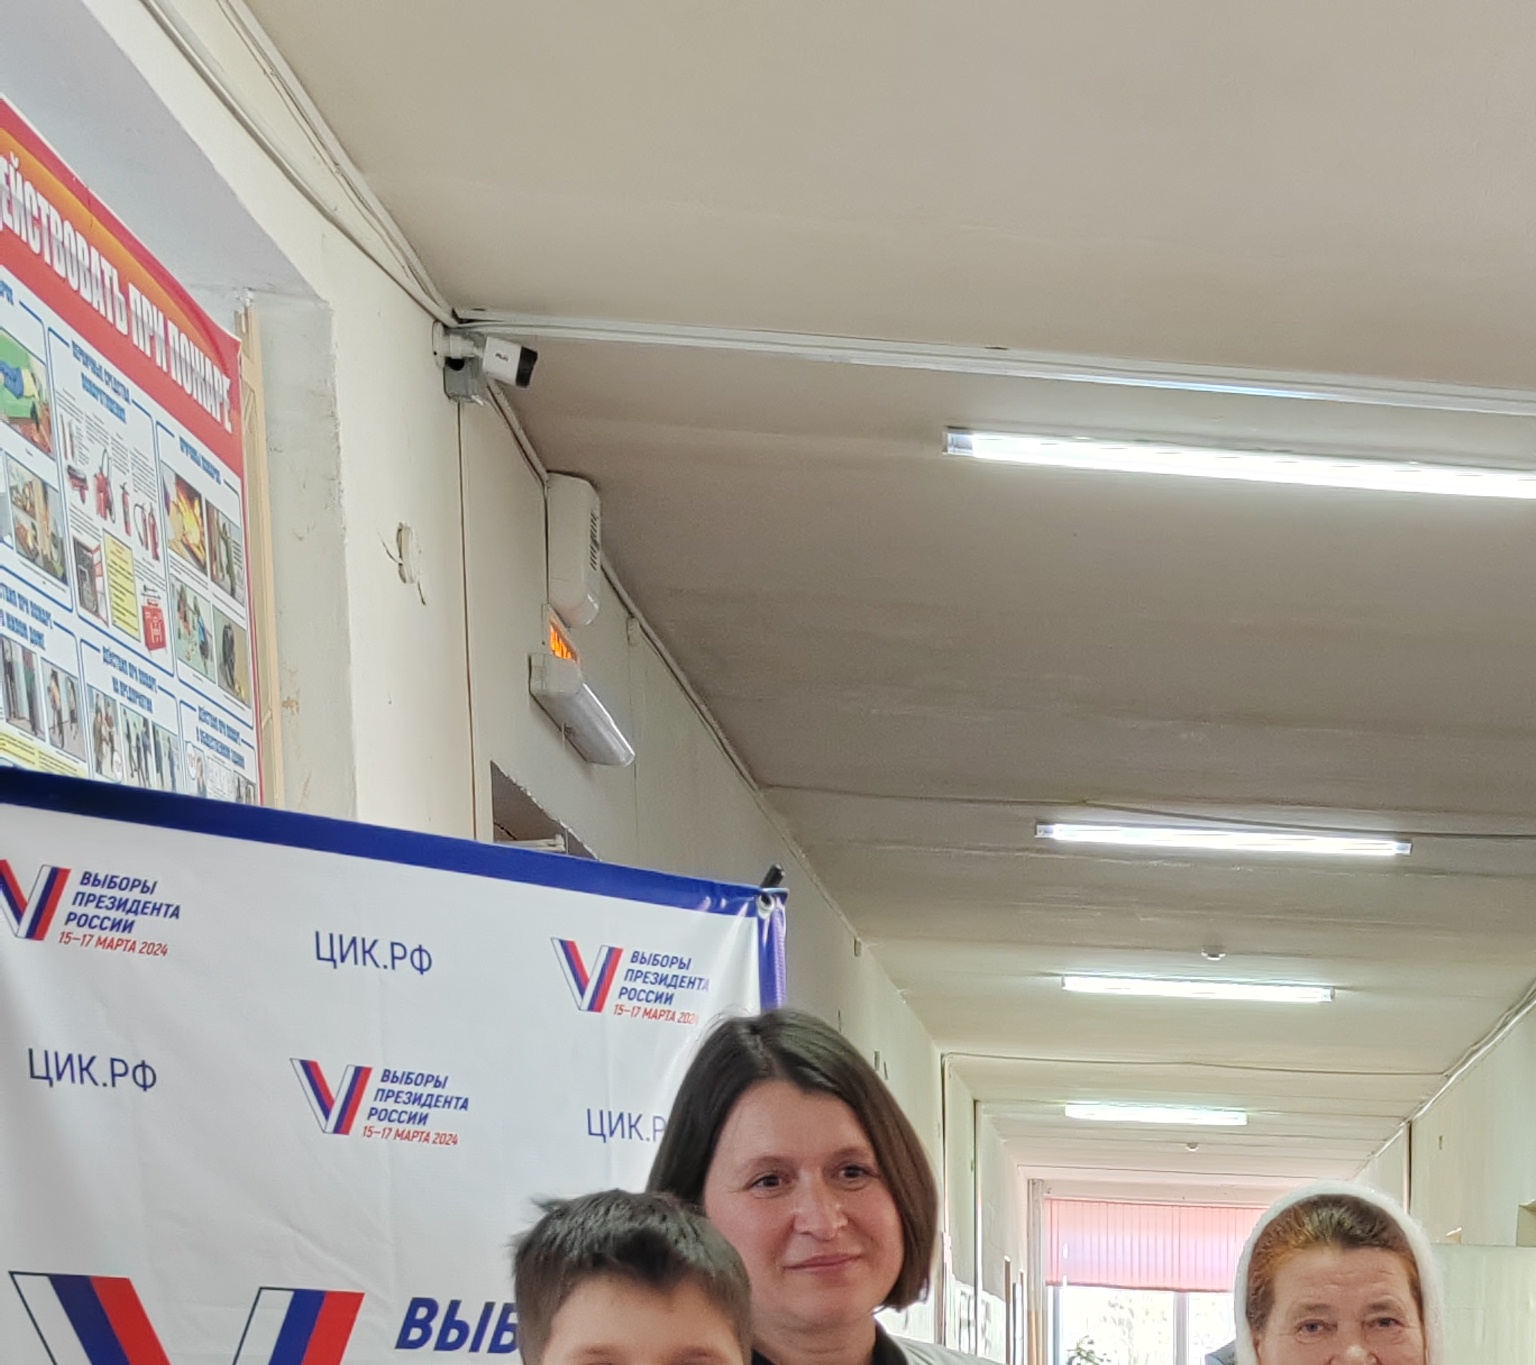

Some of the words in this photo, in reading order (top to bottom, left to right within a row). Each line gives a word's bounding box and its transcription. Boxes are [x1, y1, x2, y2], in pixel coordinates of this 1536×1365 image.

[0, 151, 129, 336] ЕЙСТВОВАТЬ
[128, 282, 167, 372] ПРИ
[168, 322, 234, 433] ПОЖАРЕ
[80, 871, 157, 895] ВЫБОРЫ
[72, 891, 181, 919] ПРЕЗИДЕНТА
[64, 912, 135, 933] РОССИИ
[95, 936, 136, 953] МАРТА
[138, 941, 168, 957] 2024
[314, 930, 433, 976] ЦИК.РФ
[630, 950, 692, 970] ВЫБОРЫ
[623, 968, 710, 992] ПРЕЗИДЕНТА
[618, 986, 675, 1005] РОССИИ
[642, 1007, 675, 1022] МАРТА
[28, 1047, 158, 1092] ЦИК.РФ
[380, 1068, 449, 1089] ВЫБОРЫ
[373, 1087, 470, 1111] ПРЕЗИДЕНТА
[367, 1106, 429, 1126] РОССИИ
[393, 1128, 430, 1144] МАРТА
[432, 1132, 459, 1146] 2024
